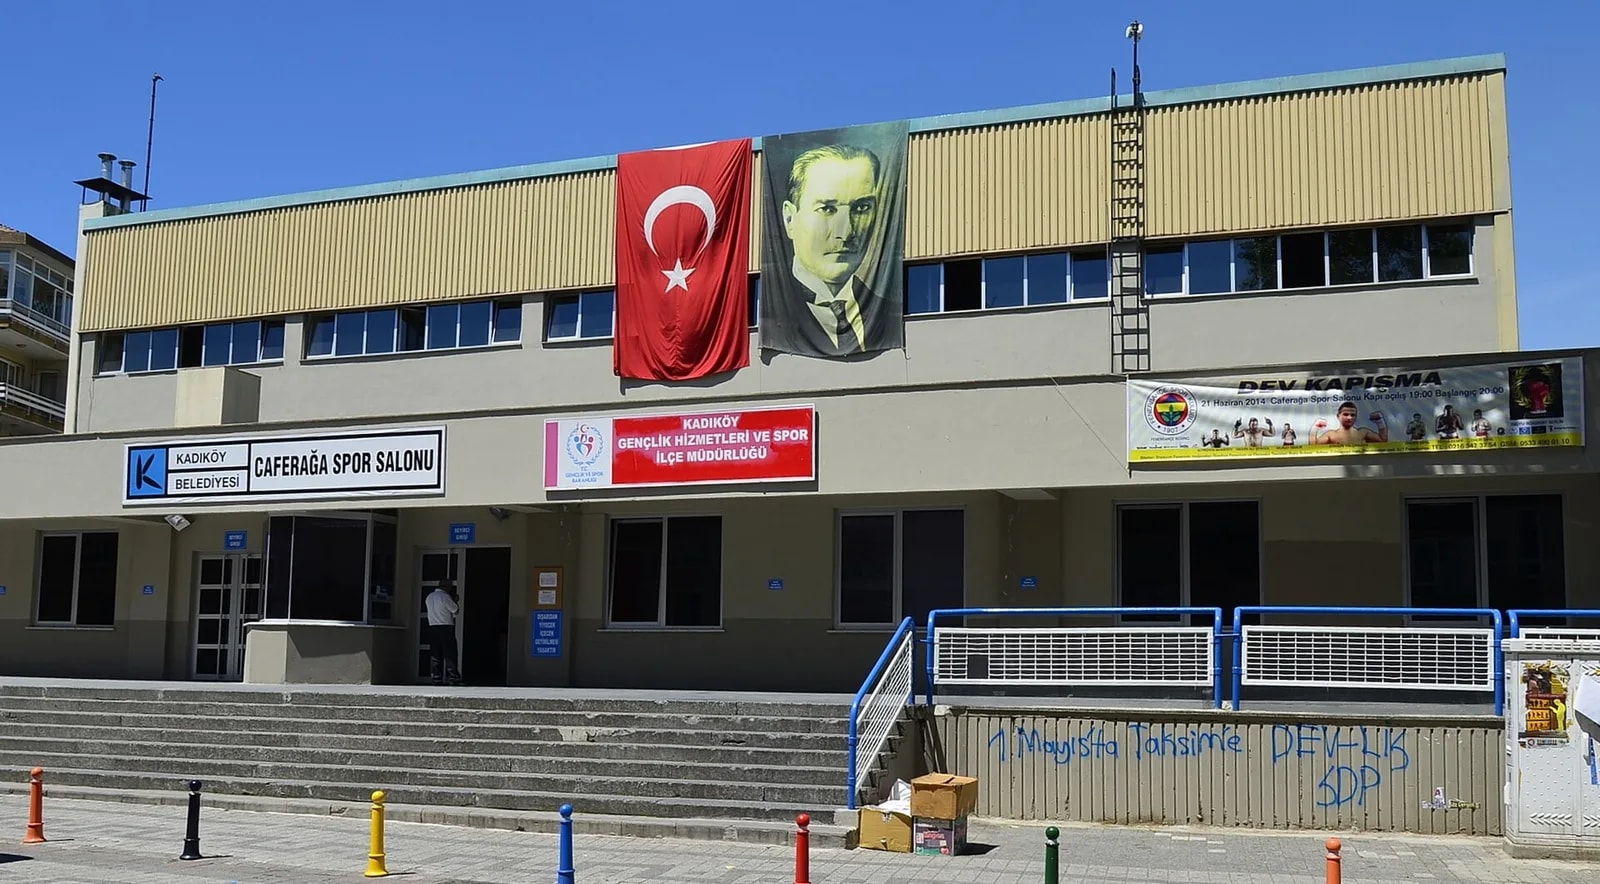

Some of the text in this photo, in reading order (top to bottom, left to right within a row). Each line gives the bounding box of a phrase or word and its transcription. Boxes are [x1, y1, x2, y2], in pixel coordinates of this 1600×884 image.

[1237, 371, 1443, 395] DEV KAPIŞMA
[1213, 399, 1244, 407] Haziran
[1246, 398, 1266, 406] 2014
[1270, 396, 1308, 406] Caferağa
[1311, 395, 1330, 404] Spor
[1332, 394, 1362, 403] Salonu
[1363, 392, 1383, 401] Kapı
[1409, 390, 1433, 398] 19:00
[1435, 389, 1477, 398] Başlangıç
[1479, 386, 1504, 394] 20:00
[682, 414, 740, 430] KADIKÖY
[1163, 426, 1179, 434] 1907
[617, 428, 809, 451] GENÇLİK HİZMETLERİ VE SPOR
[176, 448, 227, 465] KADIKÖY
[254, 448, 434, 478] CAFERAĞA SPOR SALONU
[656, 445, 768, 466] İLÇE MÜDÜRLÜĞÜ
[175, 473, 240, 490] BELEDİYESİ
[988, 727, 1006, 762] 1
